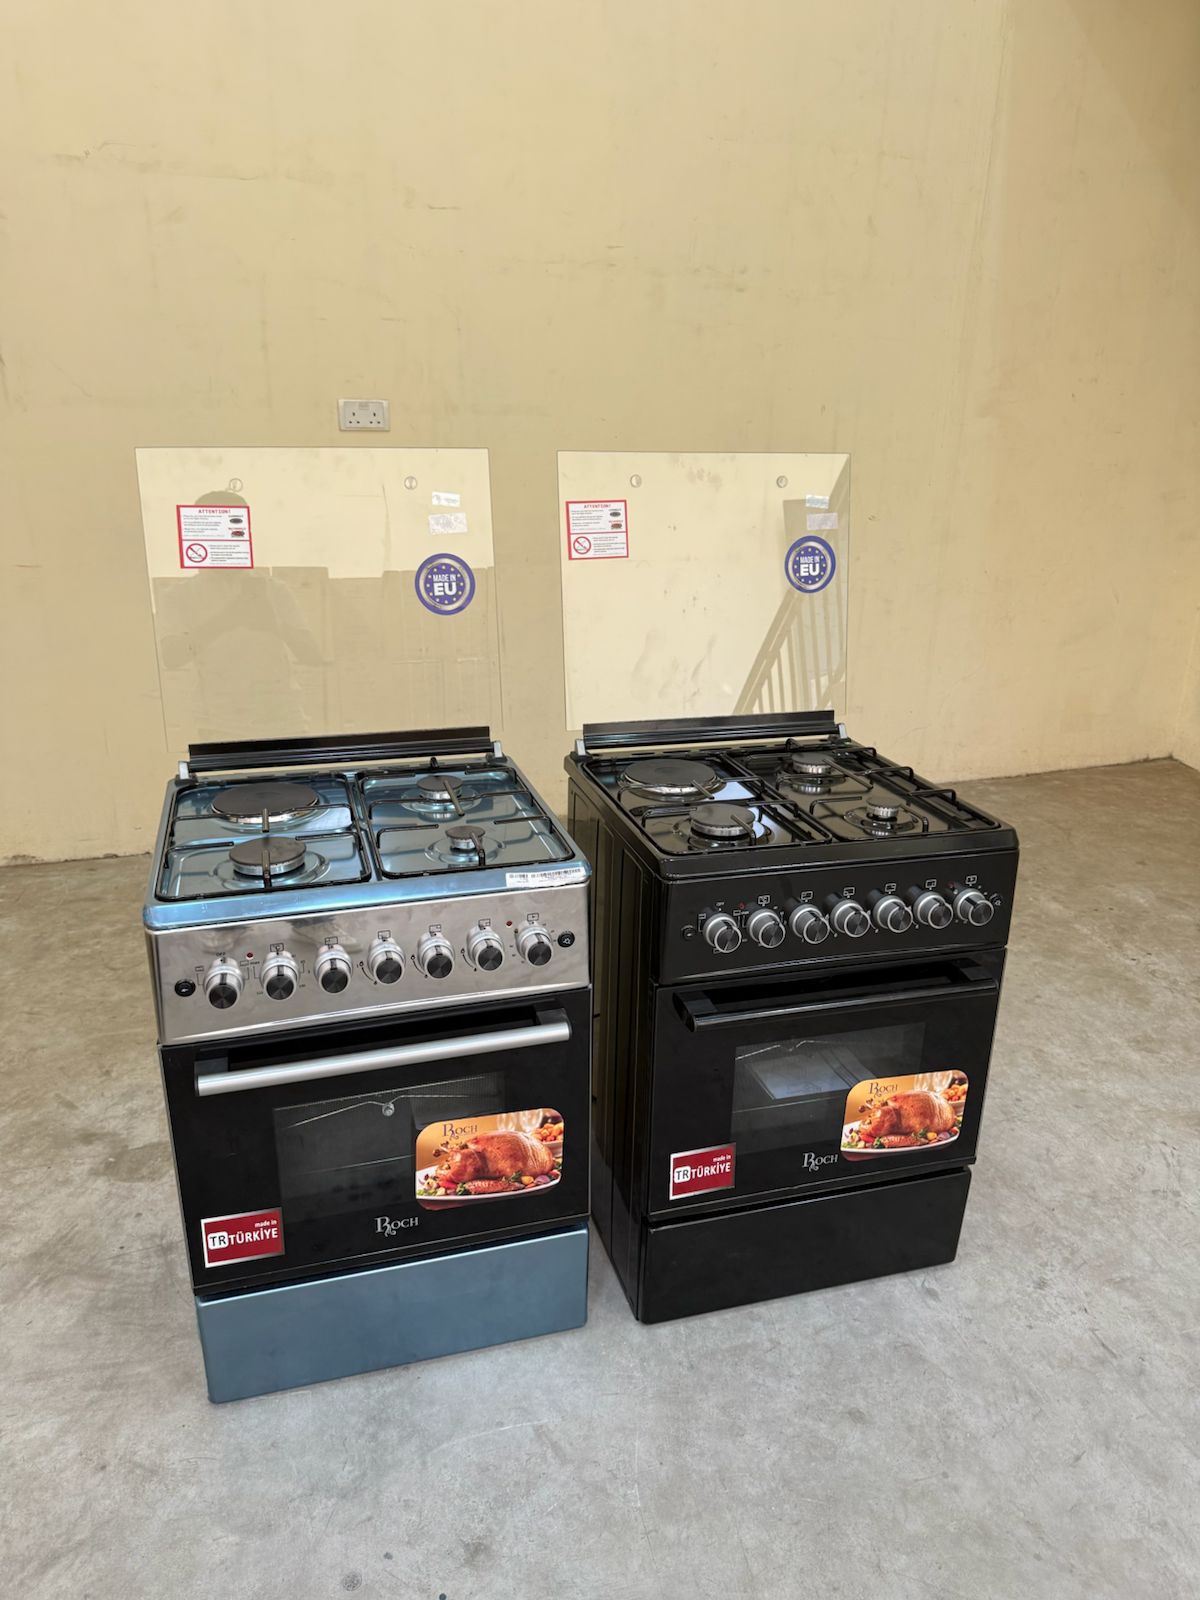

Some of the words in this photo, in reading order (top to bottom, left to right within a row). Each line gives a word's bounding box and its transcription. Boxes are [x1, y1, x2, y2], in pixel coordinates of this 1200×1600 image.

[814, 555, 820, 563] IN
[800, 564, 820, 576] EU
[433, 574, 449, 582] MADE
[449, 574, 456, 582] IN
[433, 582, 457, 596] EU
[675, 1168, 690, 1181] TR
[690, 1161, 731, 1179] TÜRKİYE
[209, 1234, 227, 1248] TR
[228, 1227, 278, 1245] TÜRKİYE
